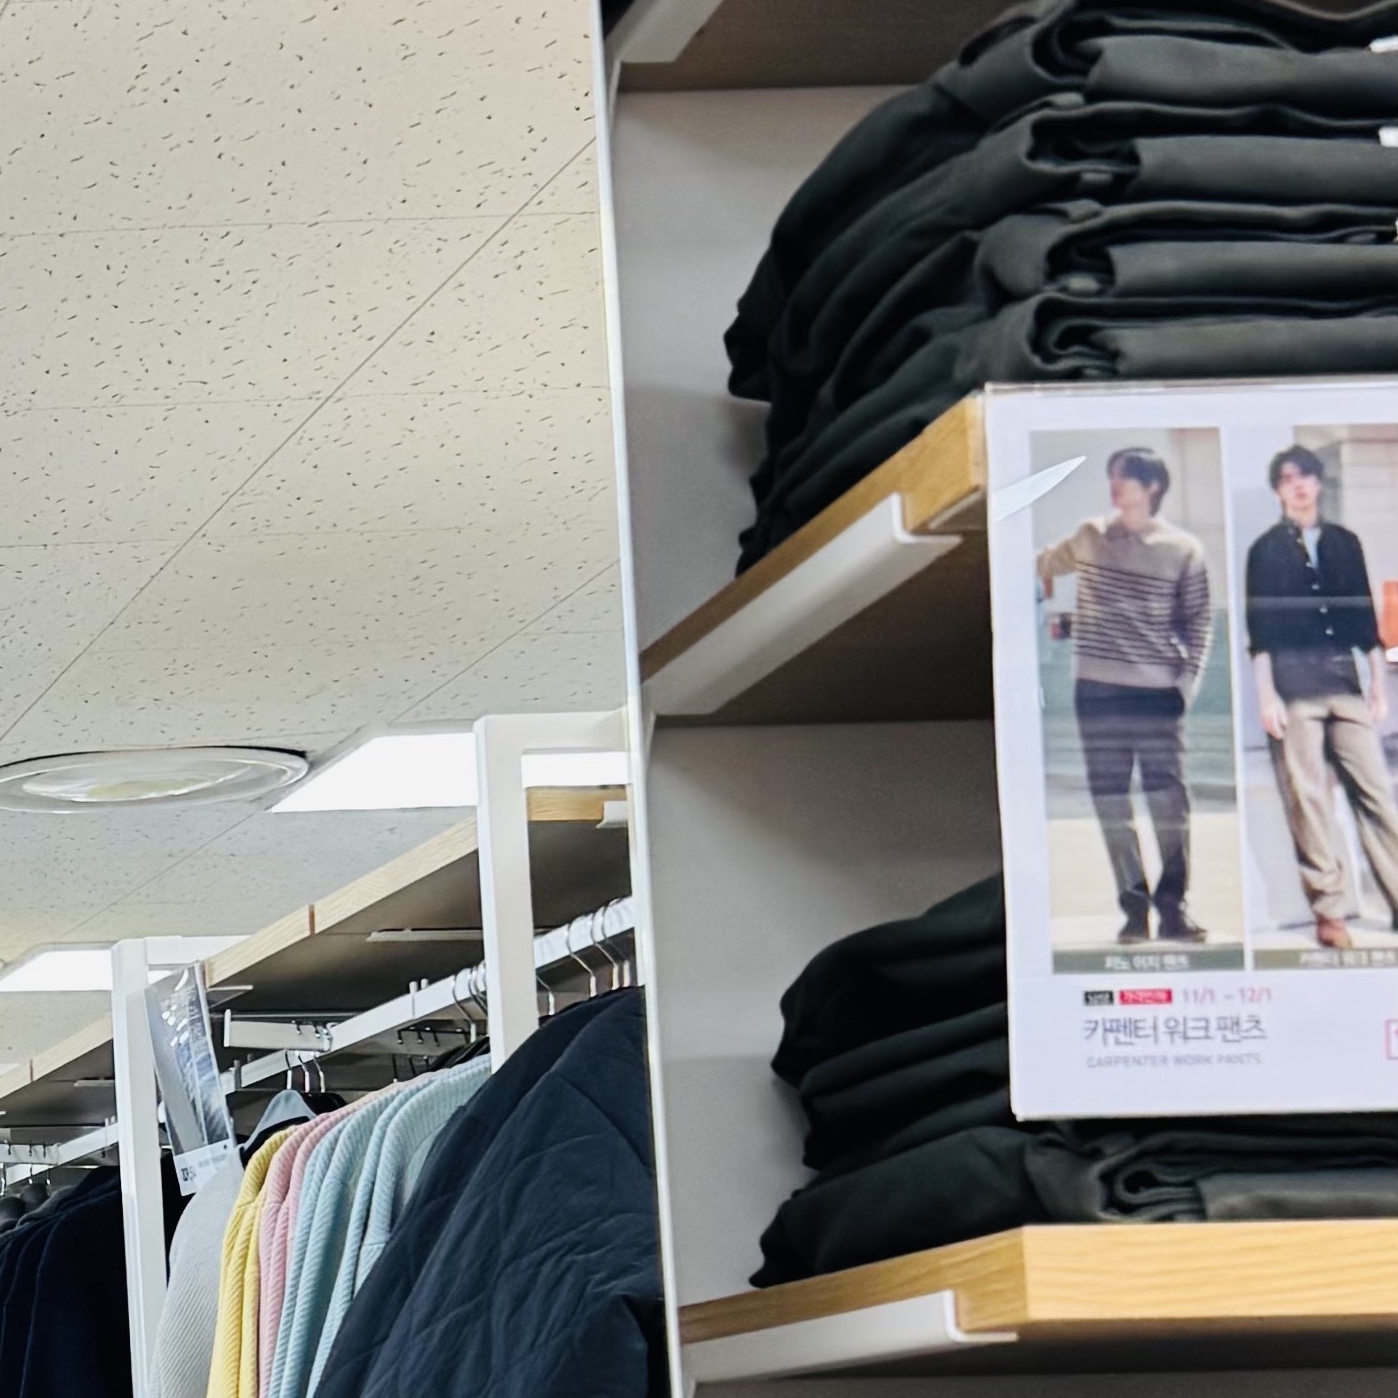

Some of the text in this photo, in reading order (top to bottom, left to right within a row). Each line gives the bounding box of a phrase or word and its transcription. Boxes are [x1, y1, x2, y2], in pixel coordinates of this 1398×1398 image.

[1083, 1014, 1267, 1047] 카펜터 워크 팬츠
